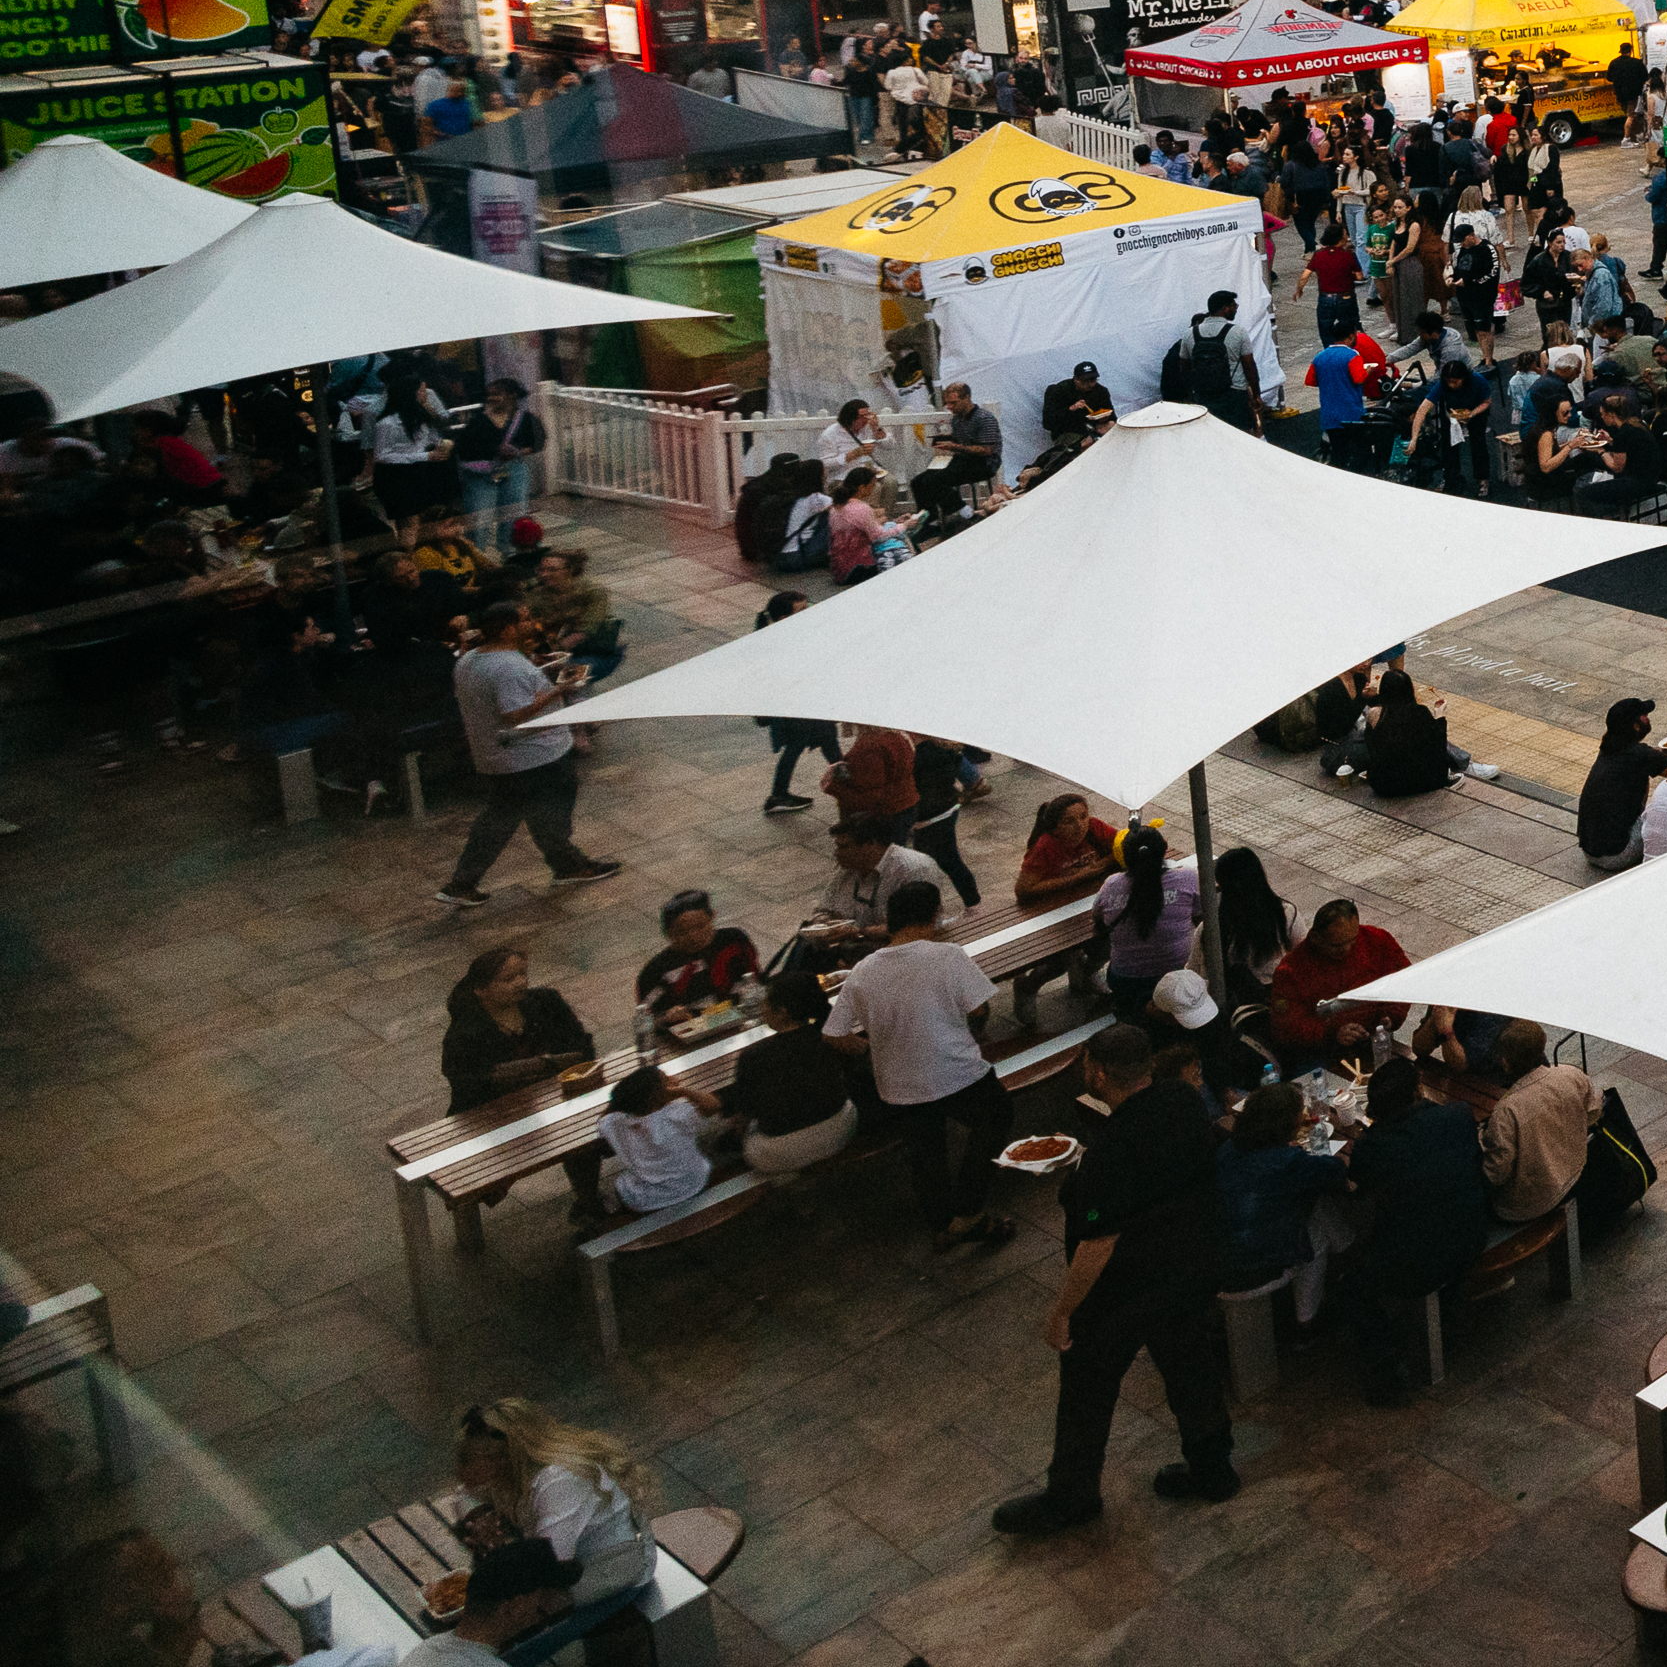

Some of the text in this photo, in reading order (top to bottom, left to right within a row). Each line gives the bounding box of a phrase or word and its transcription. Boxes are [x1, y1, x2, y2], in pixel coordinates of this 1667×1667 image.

[1270, 22, 1338, 33] WINGMAN
[1267, 49, 1399, 75] ALL ABOUT CHICKEN
[28, 78, 305, 125] JUICE STATION
[1551, 91, 1596, 106] SPANISH
[1116, 220, 1239, 256] gnocchignocchiboys.com.au
[991, 242, 1063, 266] GNOCCHI
[993, 257, 1065, 279] GNOCCHI
